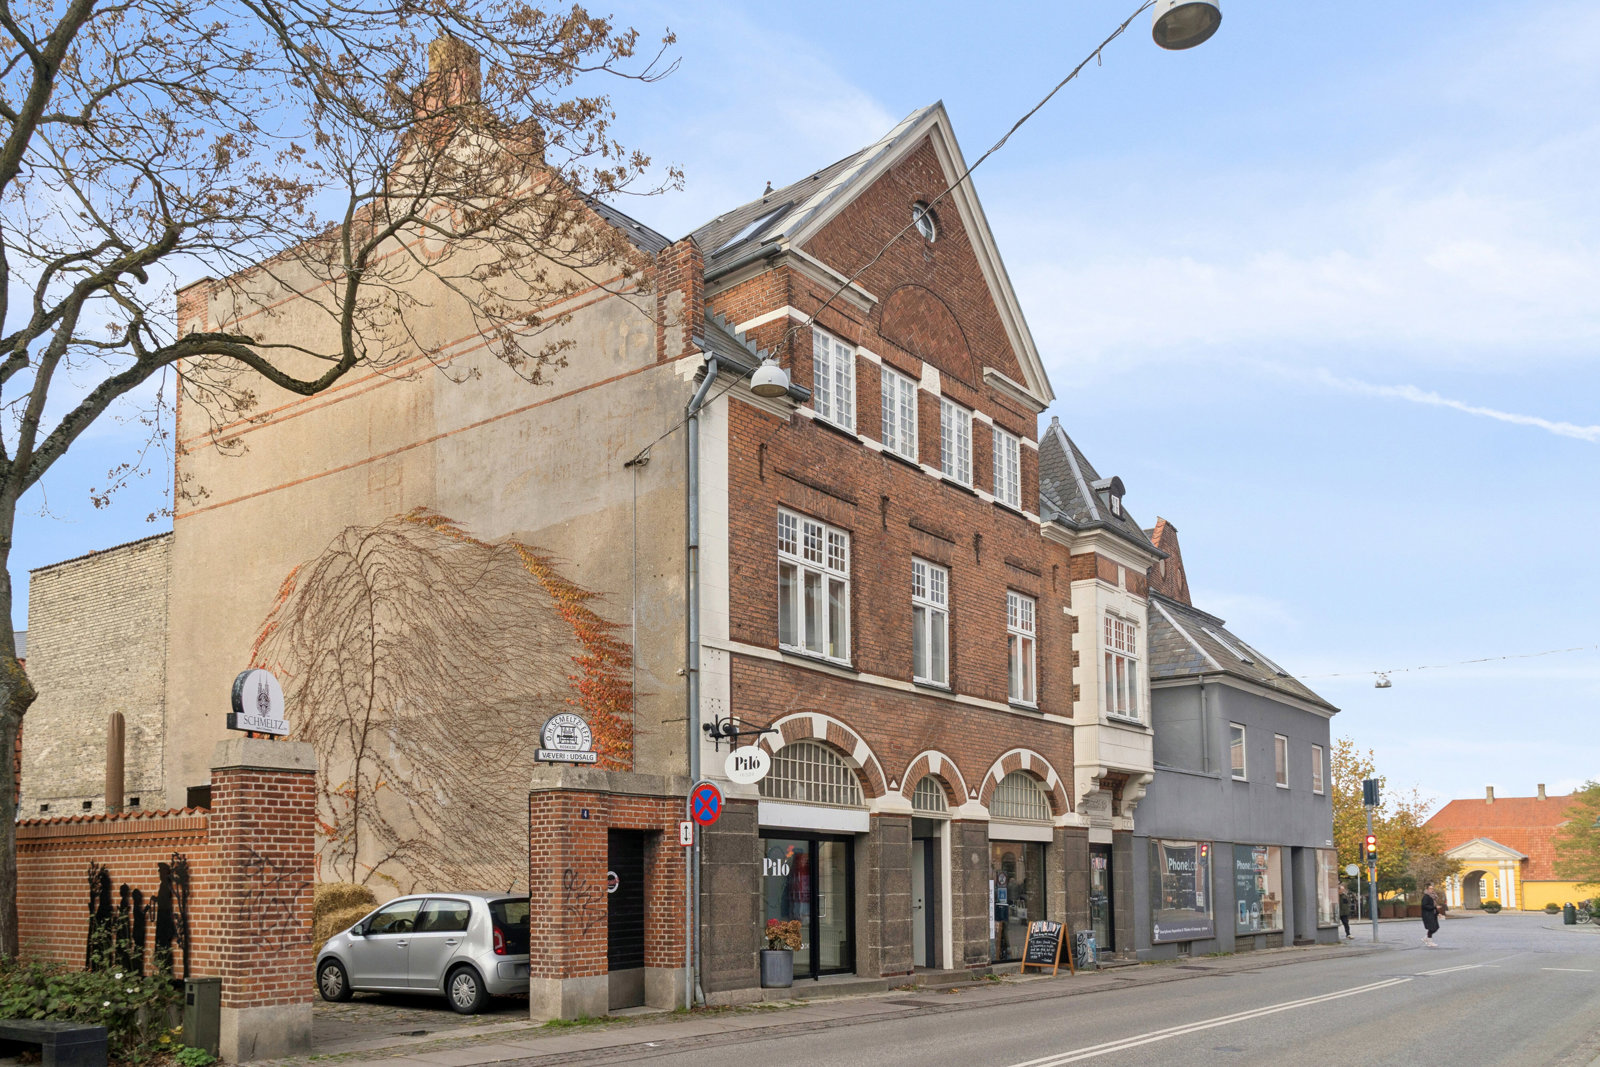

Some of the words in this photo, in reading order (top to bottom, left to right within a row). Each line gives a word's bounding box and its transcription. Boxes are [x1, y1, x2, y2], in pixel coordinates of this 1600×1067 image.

[243, 715, 283, 730] SCHMELTZ
[735, 755, 761, 771] Piló
[762, 858, 790, 876] Piló
